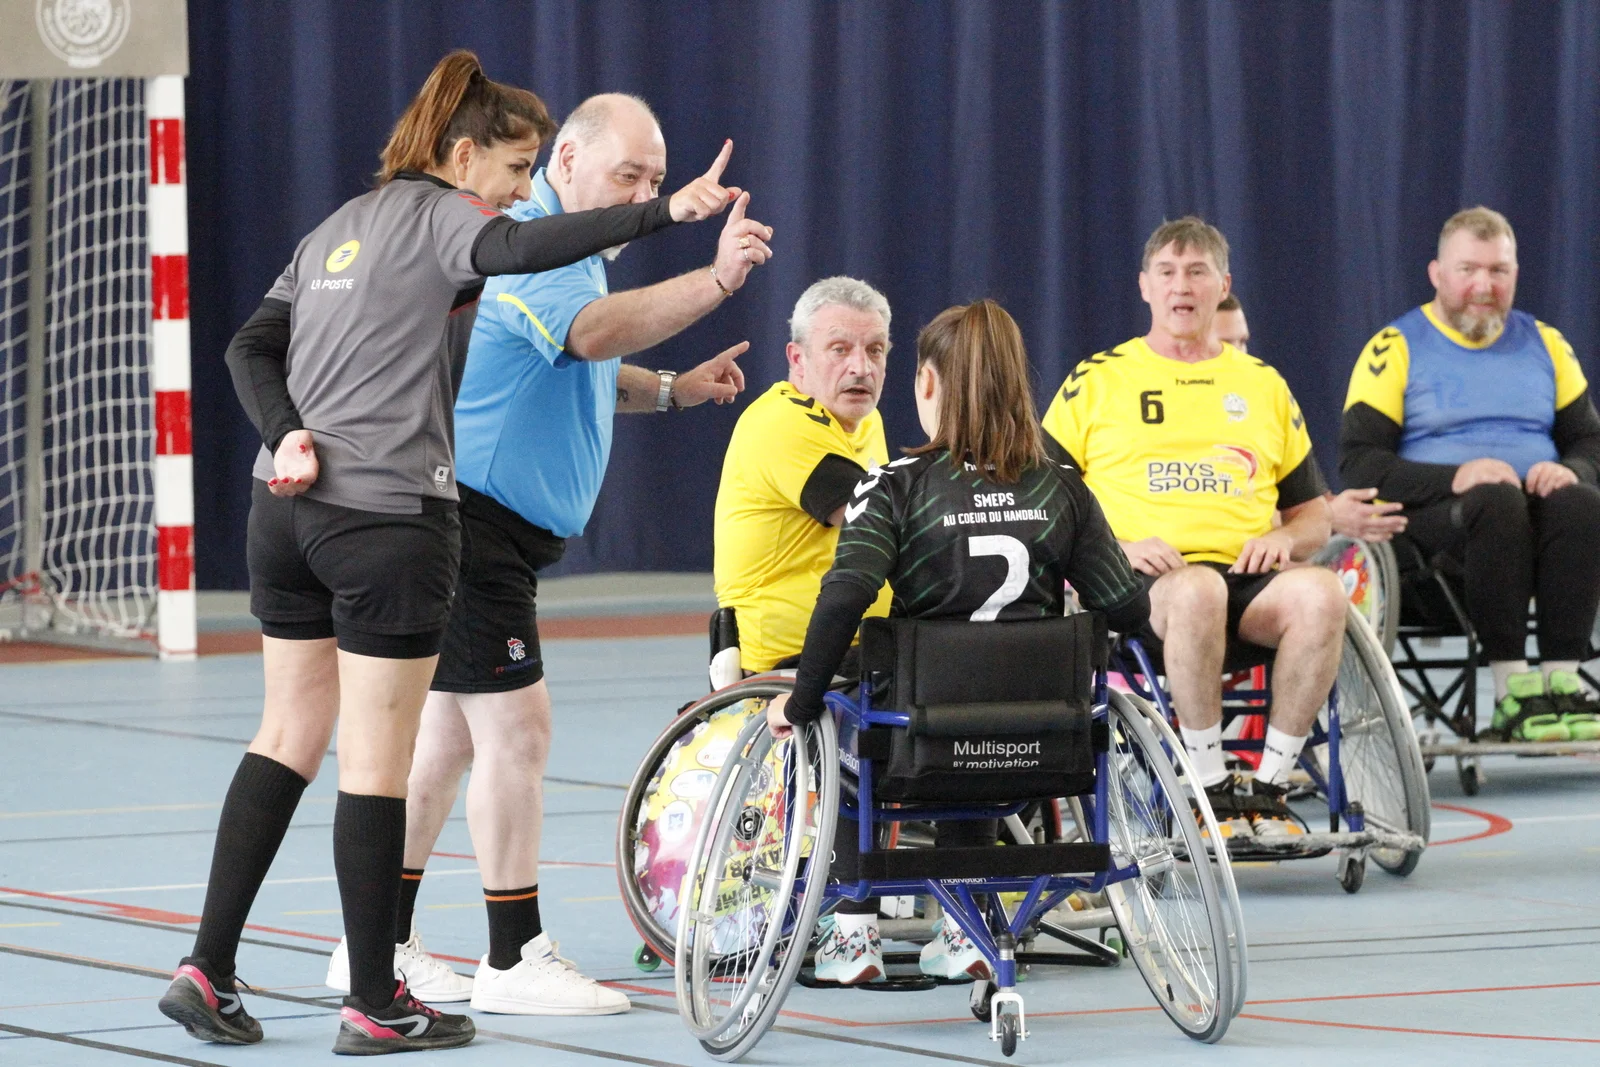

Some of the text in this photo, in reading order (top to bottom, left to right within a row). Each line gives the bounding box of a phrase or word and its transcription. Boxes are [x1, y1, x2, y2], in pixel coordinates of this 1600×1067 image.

[310, 278, 354, 290] LA POSTE
[1140, 390, 1164, 424] 6
[1148, 462, 1214, 478] PAYS
[1149, 477, 1232, 494] SPORT
[973, 492, 1015, 508] SMEPS
[943, 509, 1049, 527] AU COEUR DU HANDBALL
[953, 740, 1041, 758] Multisport
[953, 758, 1039, 769] BY motivation
